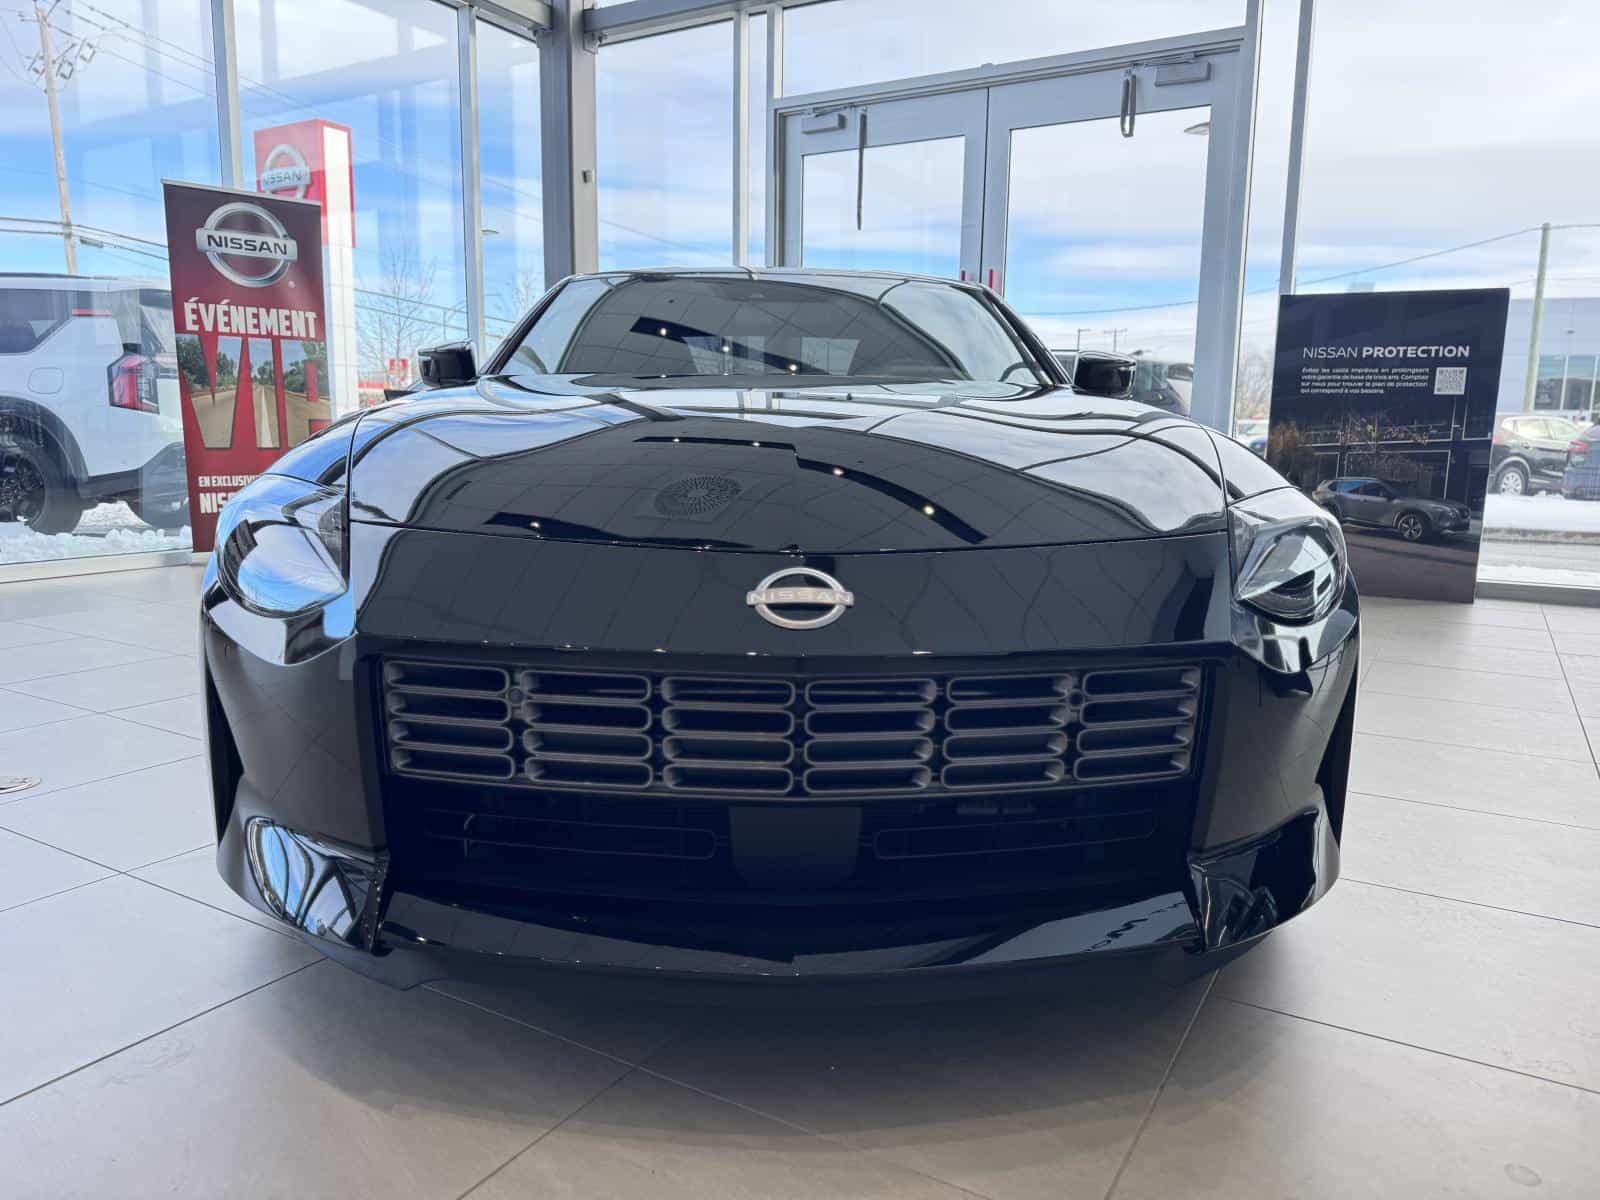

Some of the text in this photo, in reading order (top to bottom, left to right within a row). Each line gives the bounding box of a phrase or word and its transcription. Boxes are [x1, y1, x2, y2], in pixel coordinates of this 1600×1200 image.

[207, 234, 288, 255] NISSAN
[183, 297, 318, 338] ÉVÉNEMENT
[1303, 345, 1470, 359] NISSAN PROTECTION
[199, 476, 210, 487] EN
[200, 492, 234, 514] NIS
[751, 591, 849, 603] NISSAN
